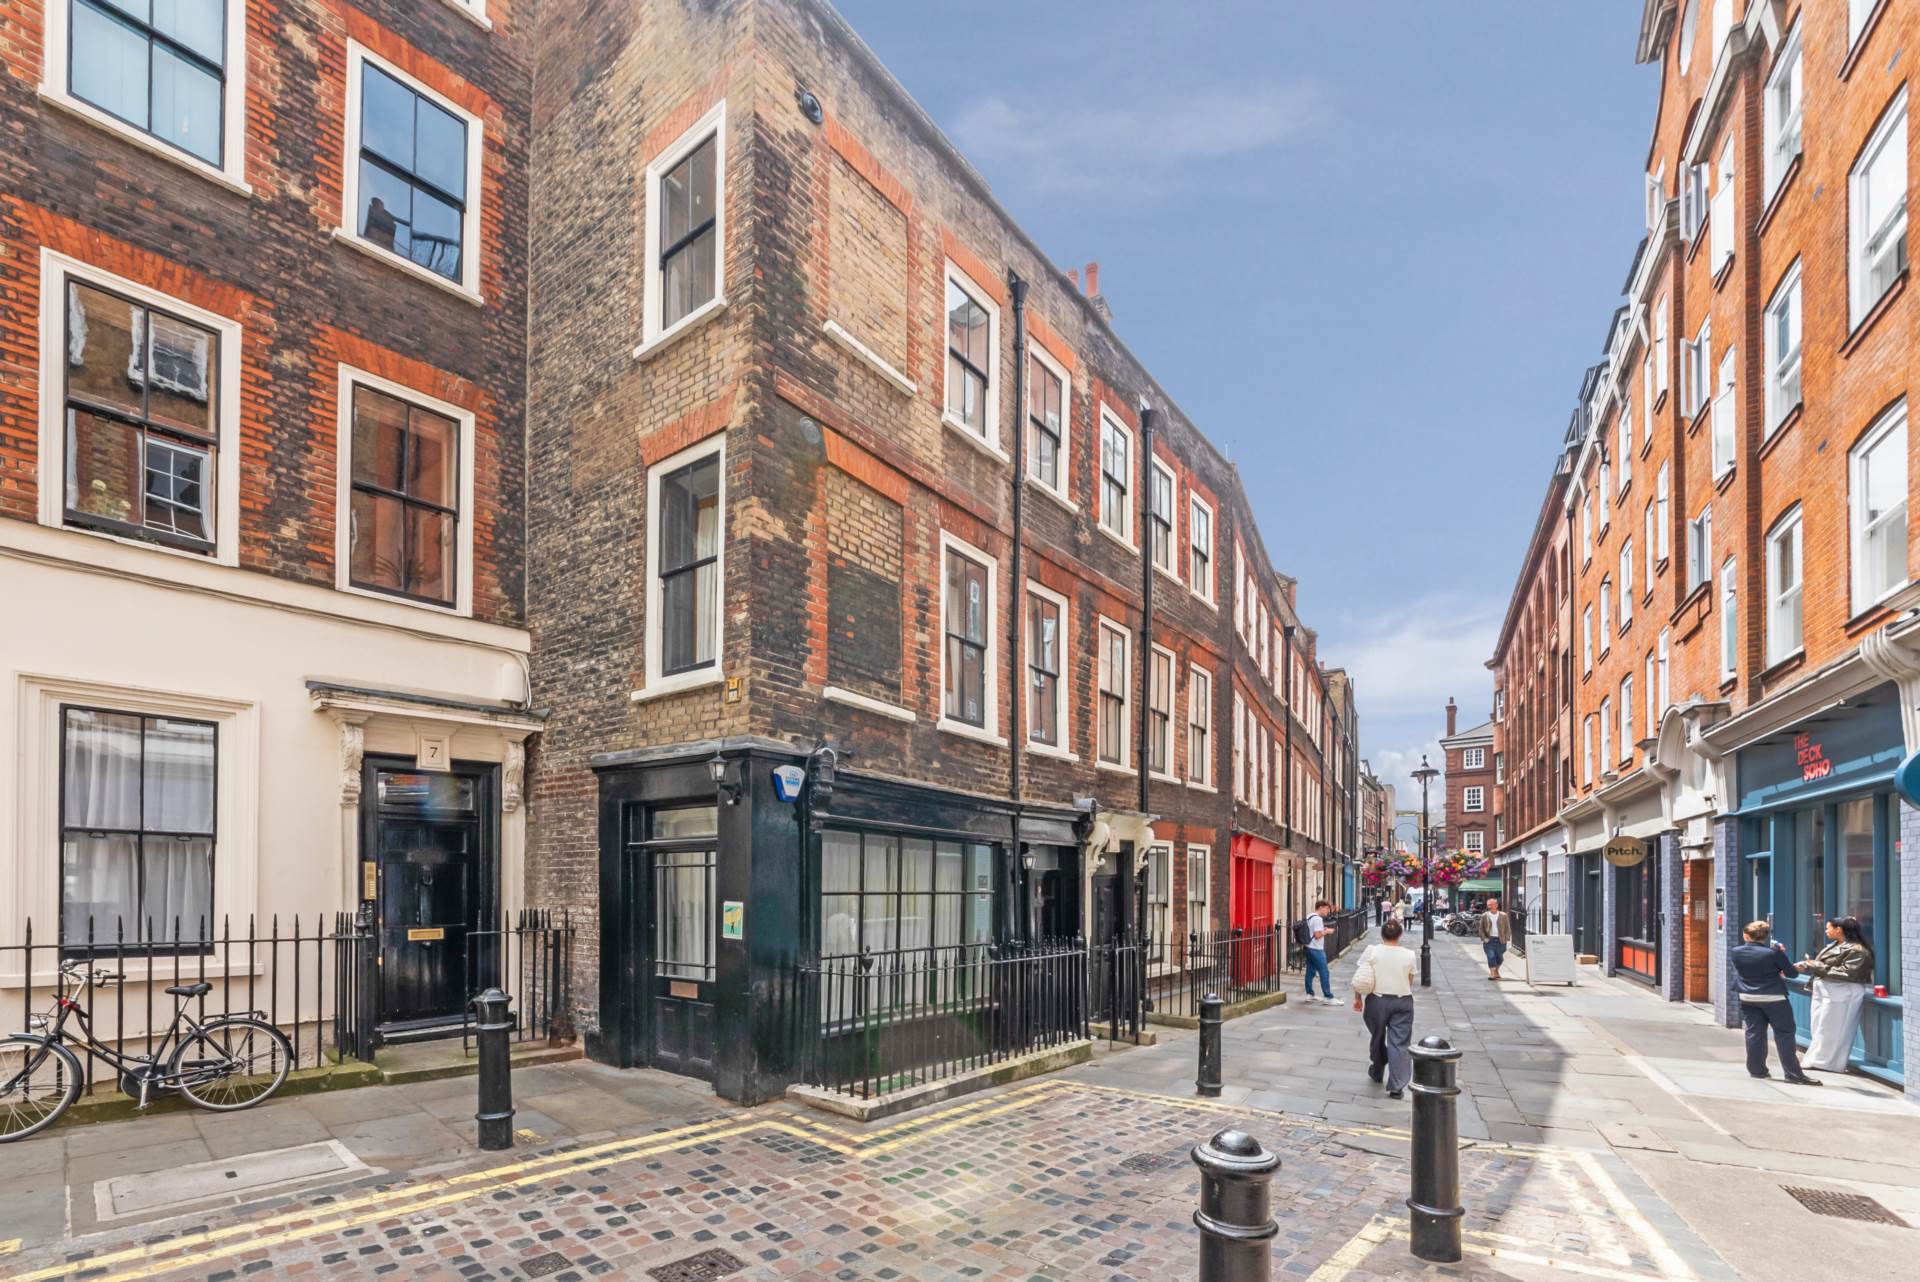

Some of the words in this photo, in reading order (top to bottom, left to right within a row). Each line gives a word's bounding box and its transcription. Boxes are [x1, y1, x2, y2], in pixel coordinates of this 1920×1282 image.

[1794, 732, 1809, 751] THE
[429, 746, 438, 758] 7
[1797, 743, 1822, 765] DECK
[1803, 759, 1831, 781] SOHO
